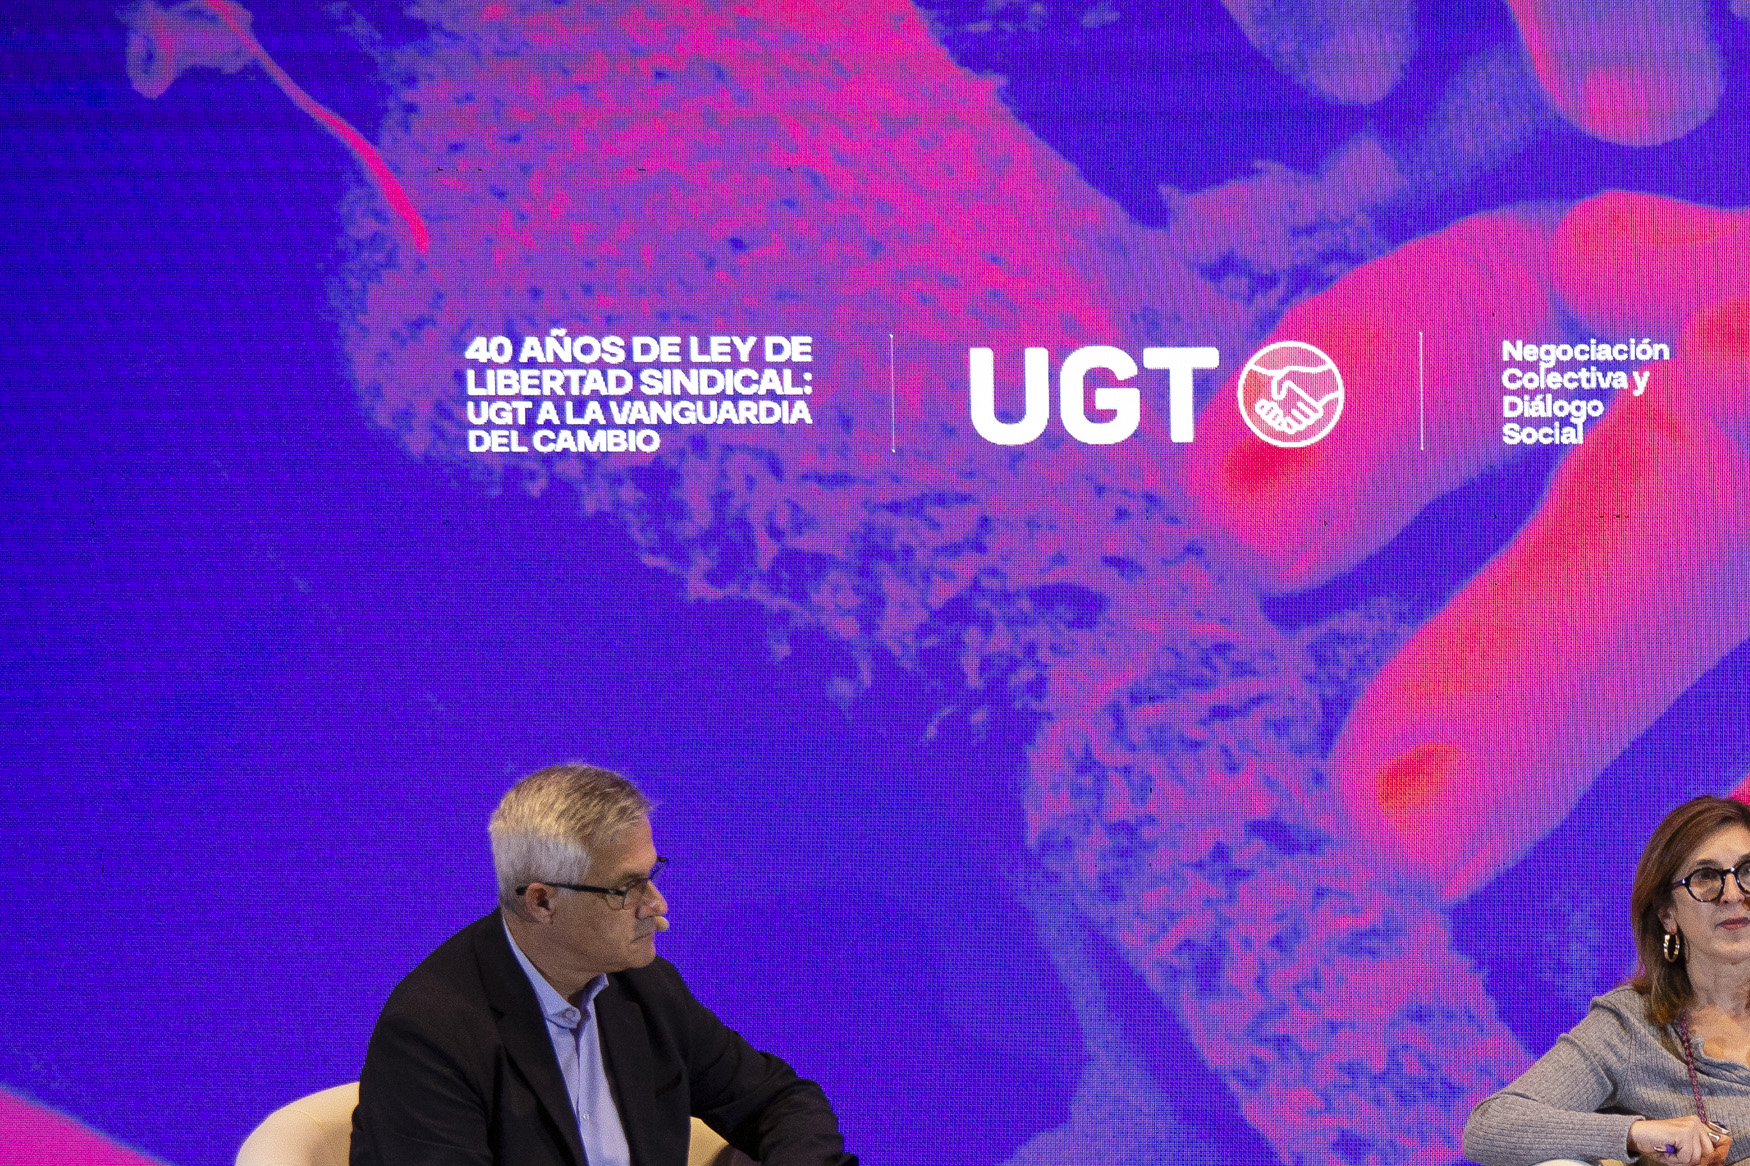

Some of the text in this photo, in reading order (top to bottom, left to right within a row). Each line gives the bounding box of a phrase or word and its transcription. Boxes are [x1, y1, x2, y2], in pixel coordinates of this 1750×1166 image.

[465, 328, 812, 363] 40 AÑOS DE LEY DE
[1502, 339, 1670, 366] Negociación
[467, 368, 813, 395] LIBERTAD SINDICAL:
[1502, 366, 1650, 396] Colectiva y
[969, 346, 1219, 445] UGT
[1503, 392, 1604, 420] Diálogo
[468, 401, 813, 425] UGT A LA VANGUARDIA
[469, 430, 660, 452] DEL CAMBIO
[1502, 420, 1583, 445] Social
